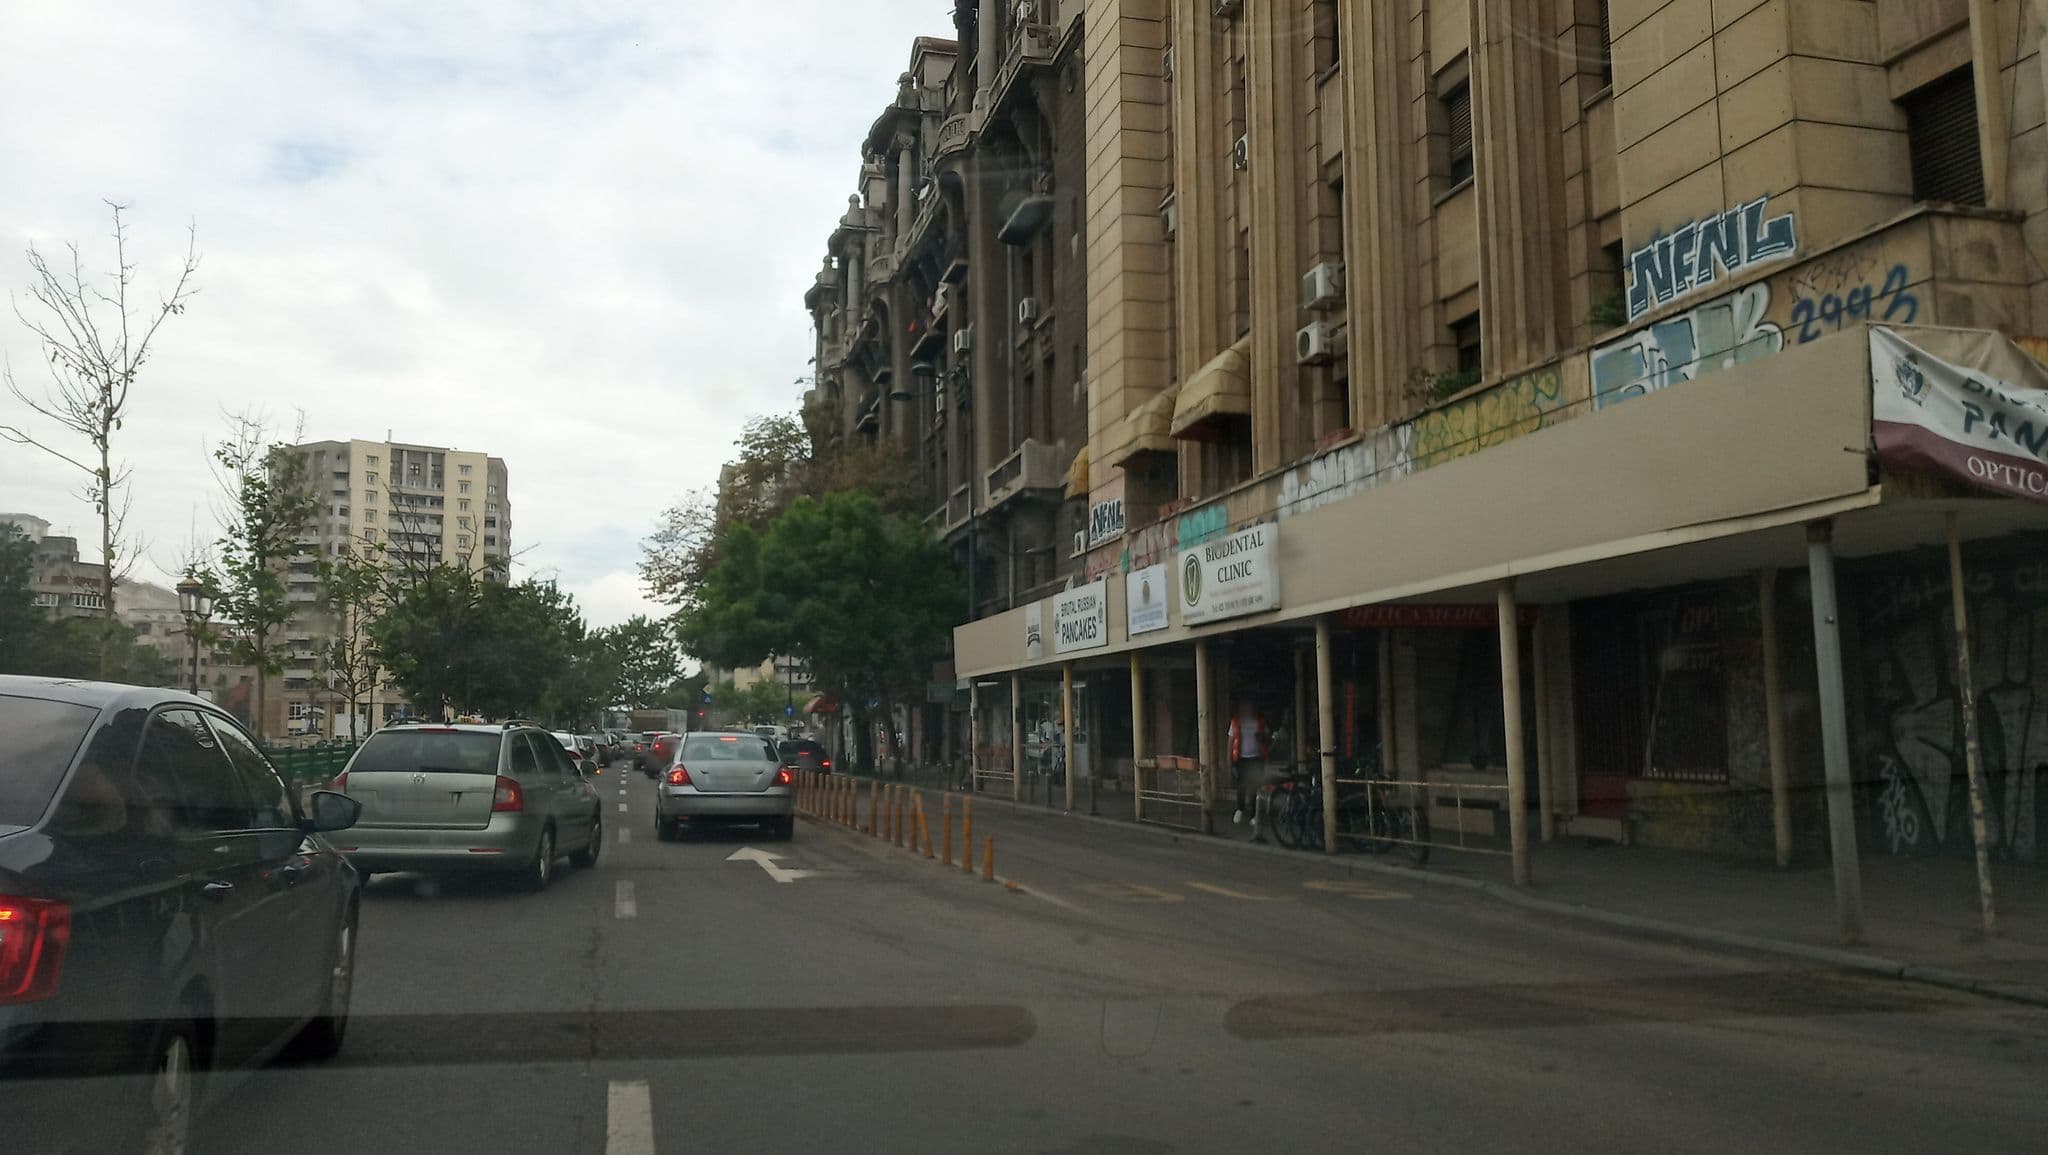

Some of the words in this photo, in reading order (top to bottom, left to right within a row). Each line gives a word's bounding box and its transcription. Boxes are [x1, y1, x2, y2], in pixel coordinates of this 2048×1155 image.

[1962, 400, 2048, 458] PAN
[1205, 530, 1264, 563] BIODENTAL
[1217, 559, 1252, 583] CLINIC
[1060, 600, 1077, 617] BRUTAL
[1077, 594, 1097, 613] RUSSIAN
[1061, 615, 1097, 645] PANCAKES
